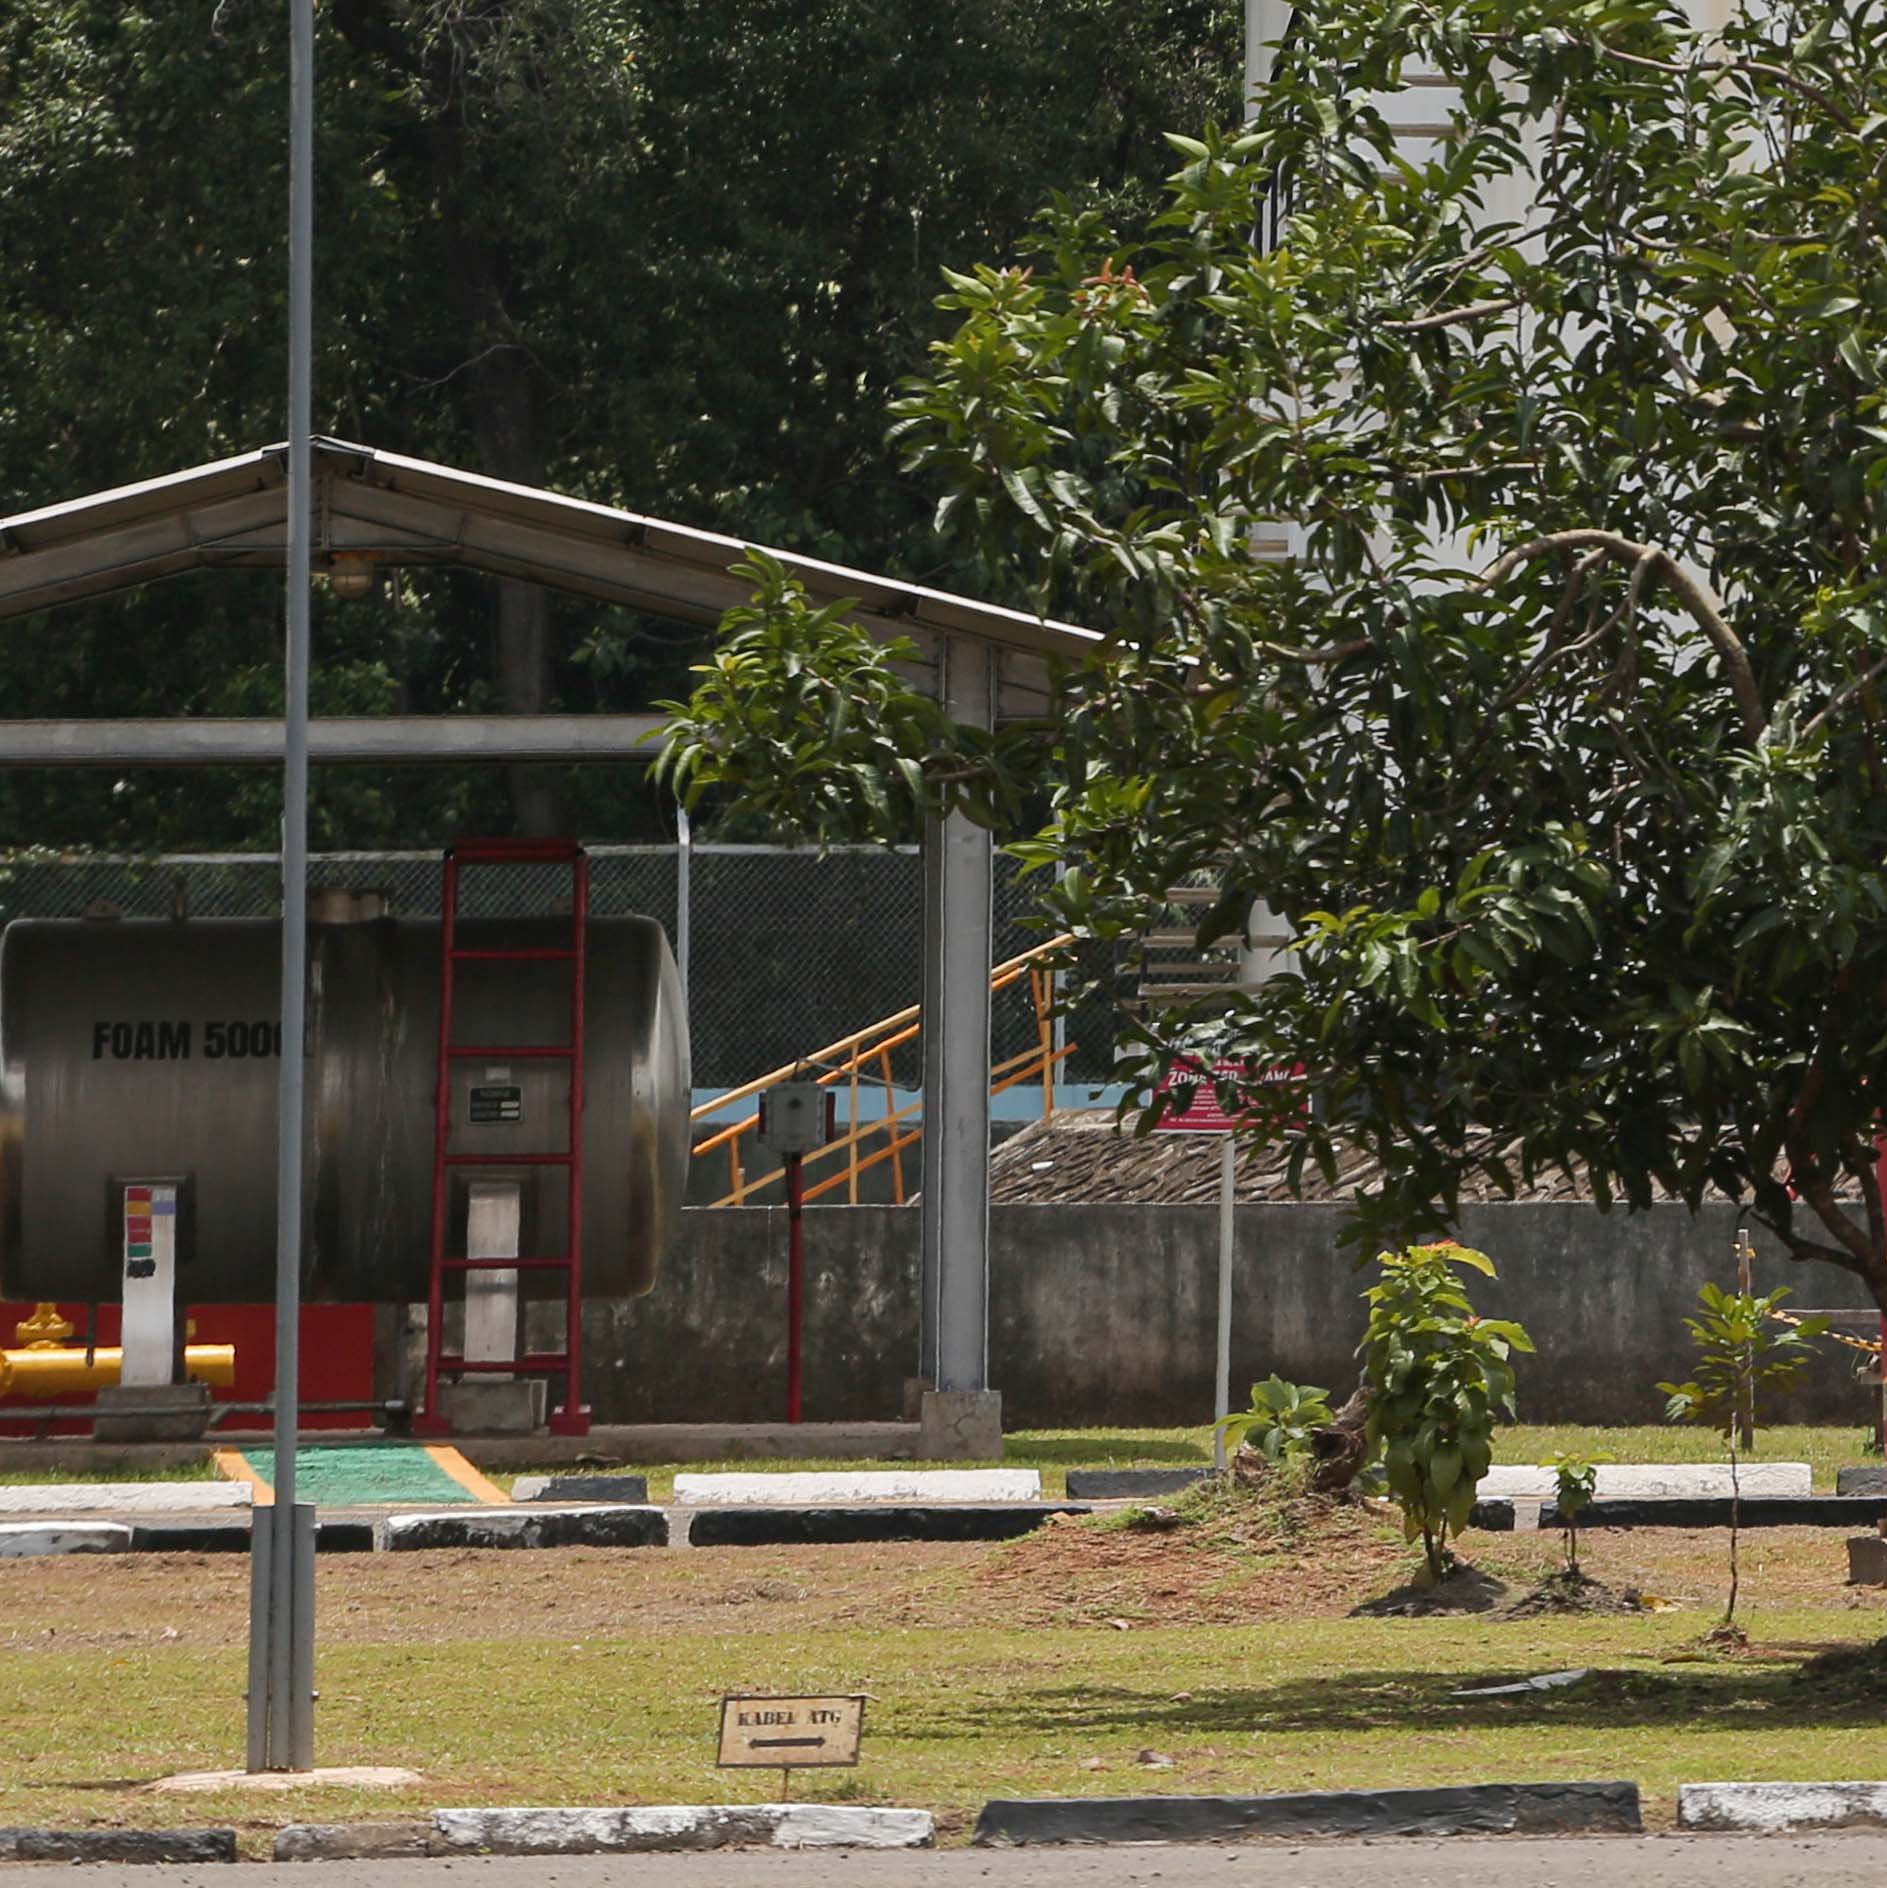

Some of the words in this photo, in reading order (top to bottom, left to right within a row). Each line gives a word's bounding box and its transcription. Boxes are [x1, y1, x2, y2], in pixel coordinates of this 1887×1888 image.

[93, 1020, 191, 1060] FOAM
[738, 1711, 796, 1726] KABEL
[807, 1710, 841, 1724] ATG
